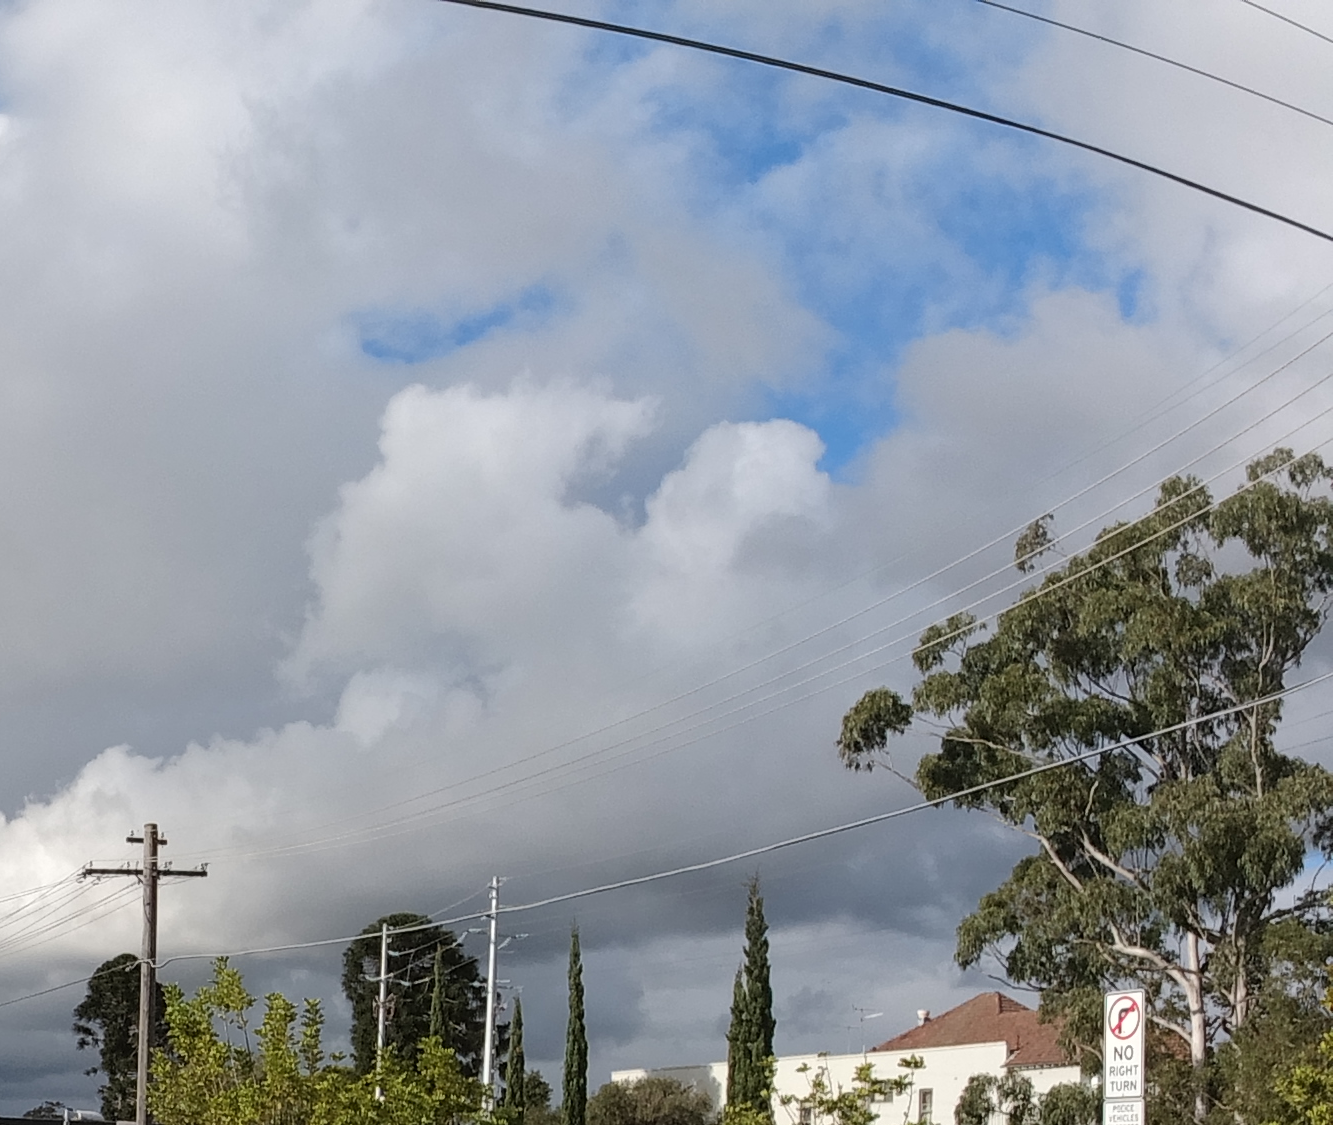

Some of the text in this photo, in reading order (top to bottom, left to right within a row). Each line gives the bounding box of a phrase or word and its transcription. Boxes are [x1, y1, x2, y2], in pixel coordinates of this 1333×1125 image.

[1113, 1044, 1134, 1062] NO
[1108, 1064, 1139, 1077] RIGHT
[1109, 1080, 1137, 1092] TURN
[1112, 1104, 1135, 1113] POLICE
[1108, 1113, 1139, 1123] VEHICLES
